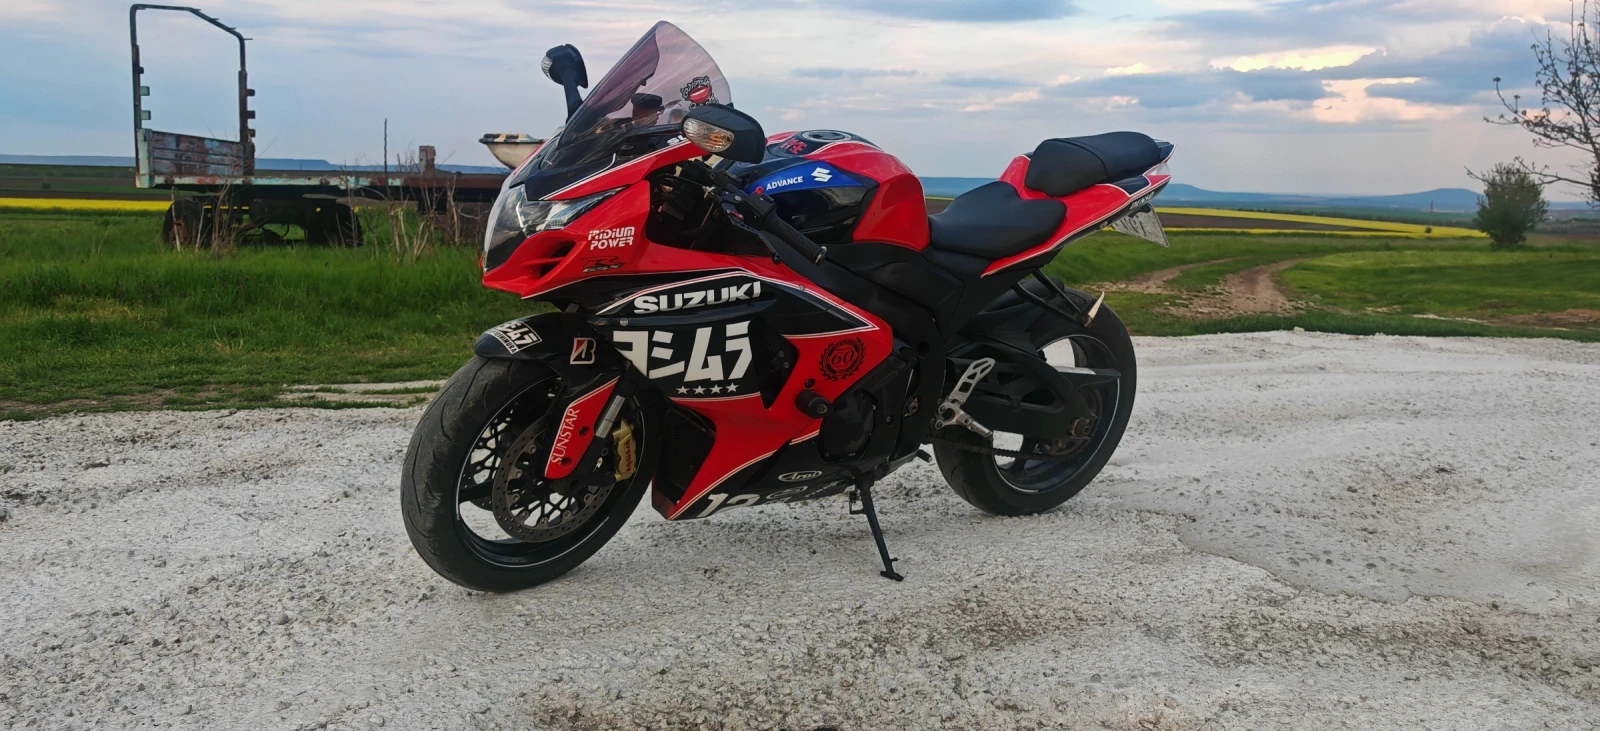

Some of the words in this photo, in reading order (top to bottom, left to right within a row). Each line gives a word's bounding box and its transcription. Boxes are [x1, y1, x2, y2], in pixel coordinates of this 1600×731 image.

[765, 176, 804, 191] ADVANCE
[590, 236, 634, 251] POWER
[633, 280, 762, 314] SUZUKI
[831, 349, 855, 365] 60
[550, 408, 580, 465] SUNSTAR
[785, 471, 818, 480] Arai
